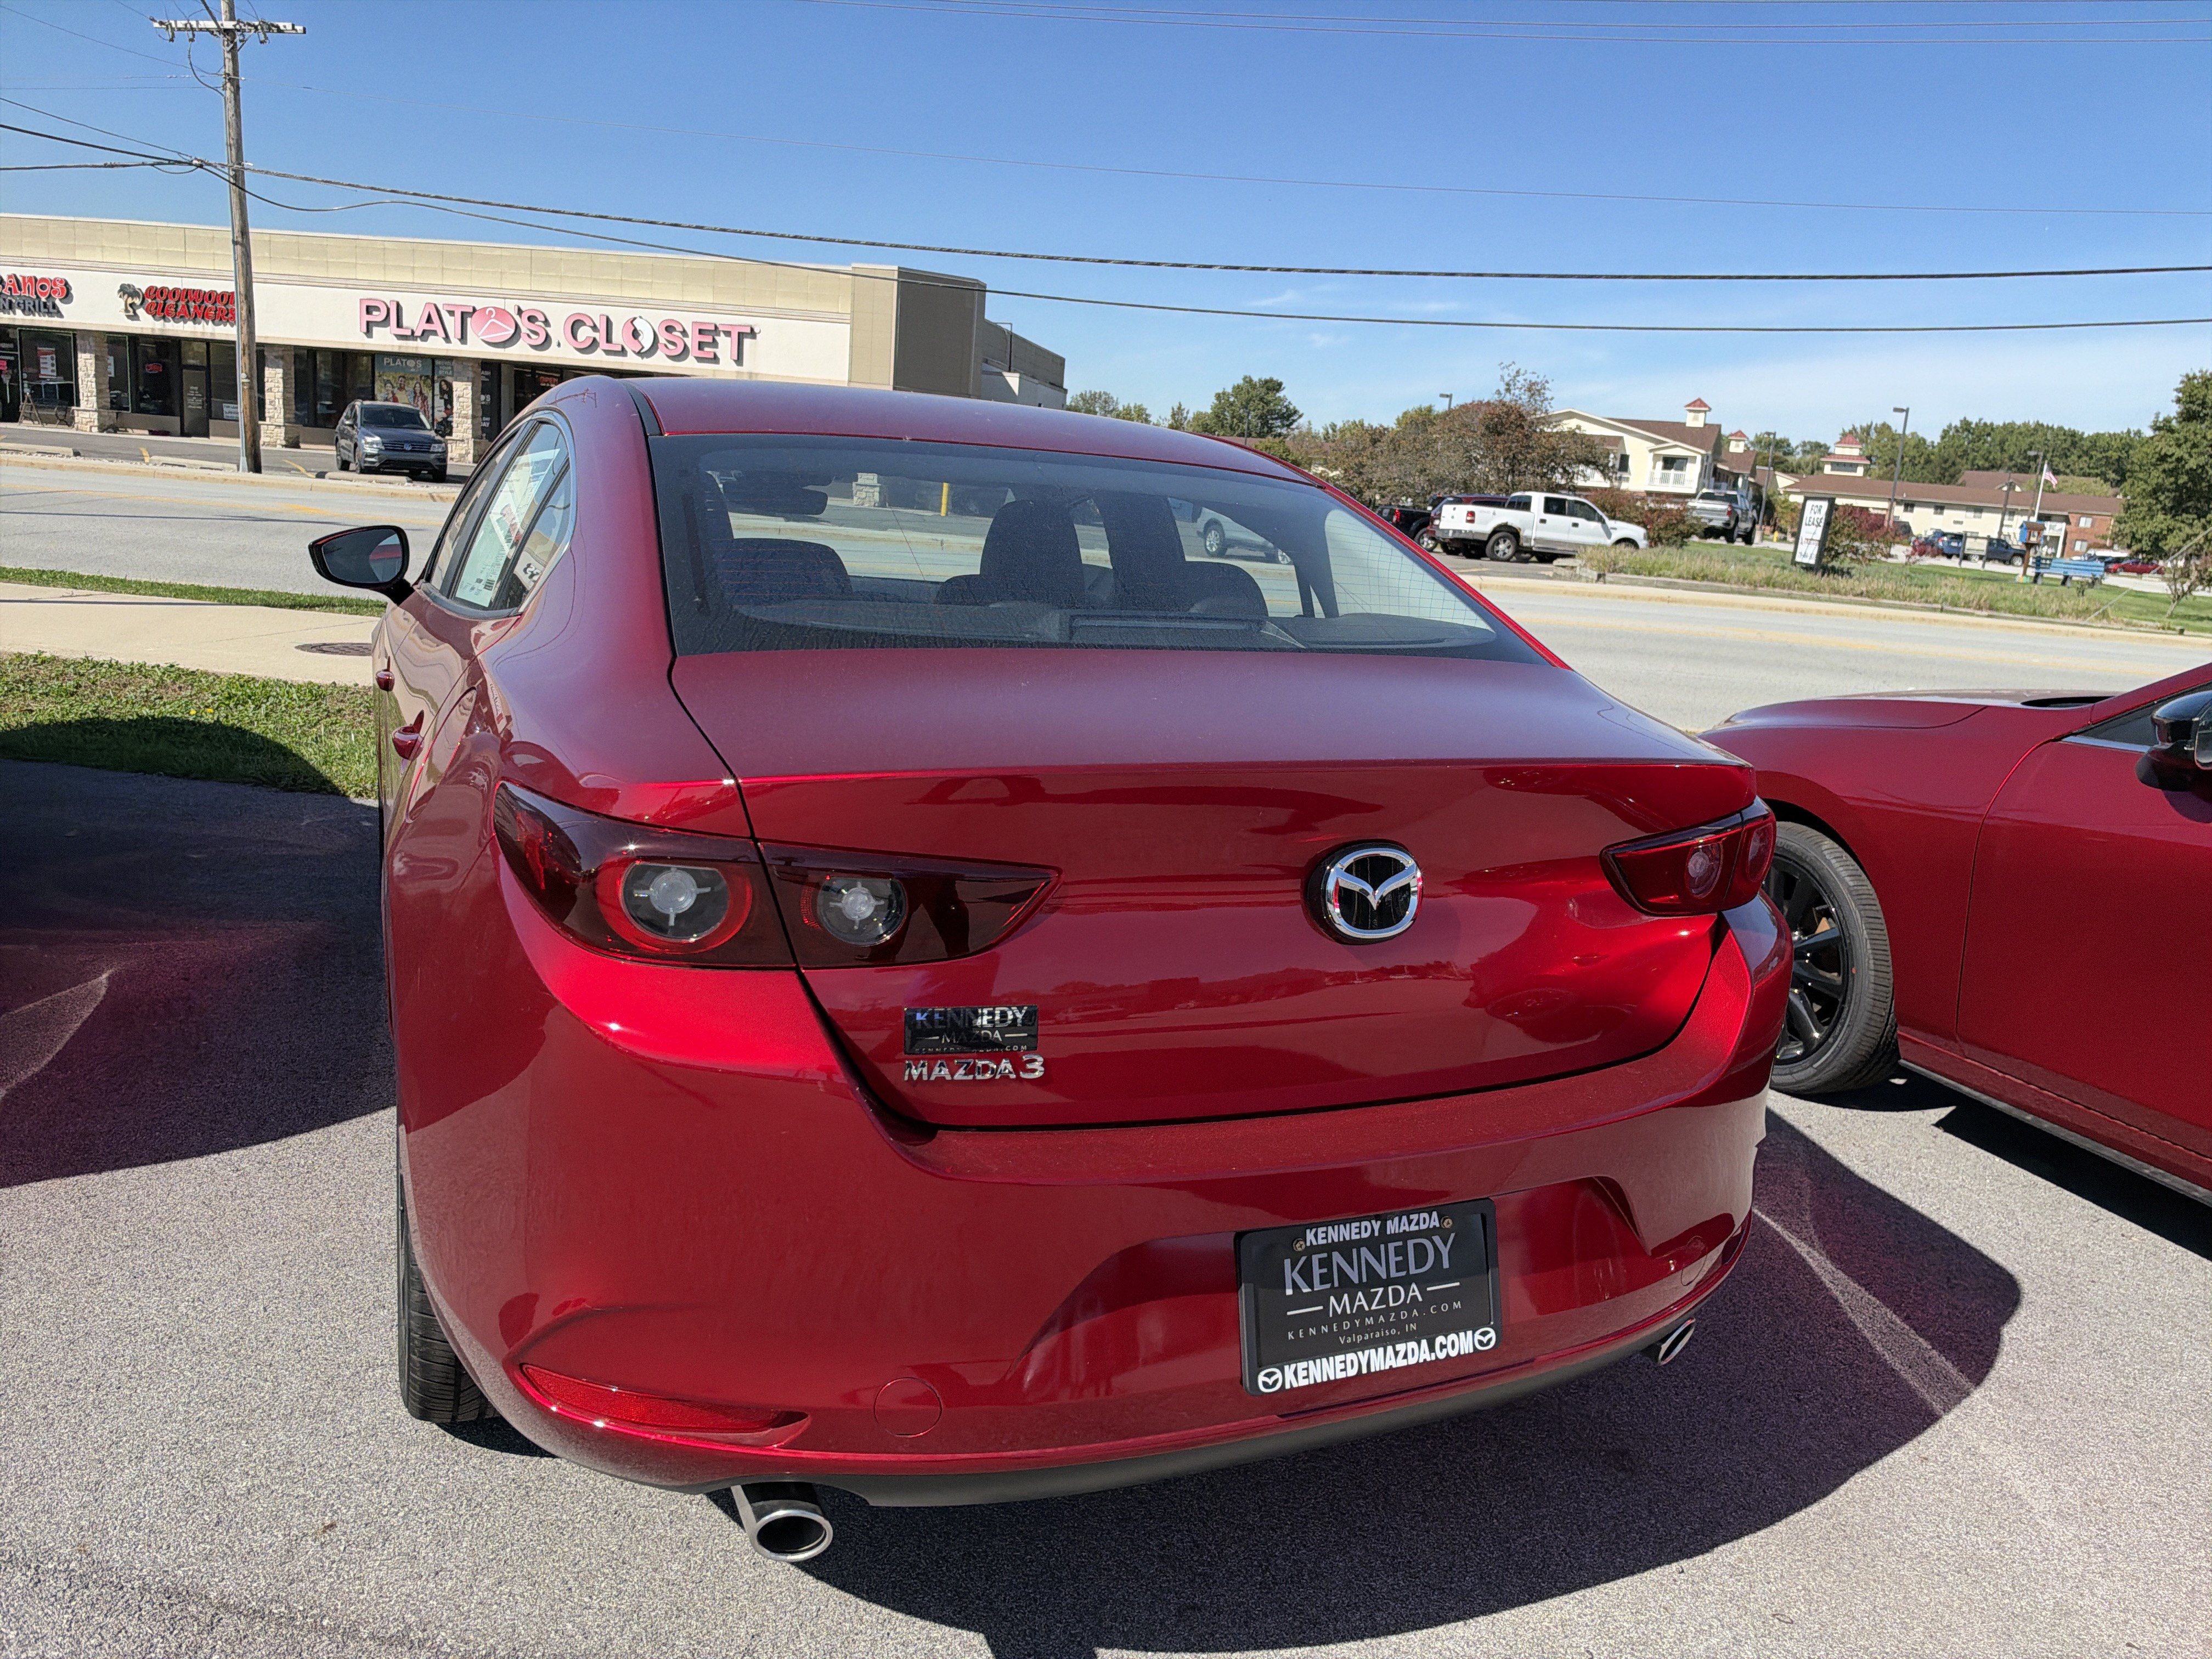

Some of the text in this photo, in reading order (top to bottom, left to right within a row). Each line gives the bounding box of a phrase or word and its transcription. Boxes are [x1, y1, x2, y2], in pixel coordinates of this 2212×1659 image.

[0, 274, 66, 299] ANOS
[16, 298, 57, 312] GRILL
[145, 301, 236, 323] CLEANERS
[359, 298, 751, 360] PLATO'S CLOSET
[1805, 516, 1823, 527] LEASE
[1810, 504, 1823, 515] FOR
[916, 1006, 1028, 1029] KENNEDY
[941, 1030, 1002, 1045] MAZDA
[1305, 1211, 1440, 1246] KENNEDY MAZDA
[1284, 1232, 1455, 1296] KENNEDY
[1329, 1282, 1423, 1317] MAZDA
[1288, 1300, 1462, 1340] KENNEDYMAZDA.COM
[1339, 1322, 1417, 1345] Valparaiso, IN
[1284, 1330, 1474, 1390] KENNEDYMAZDA.COM
